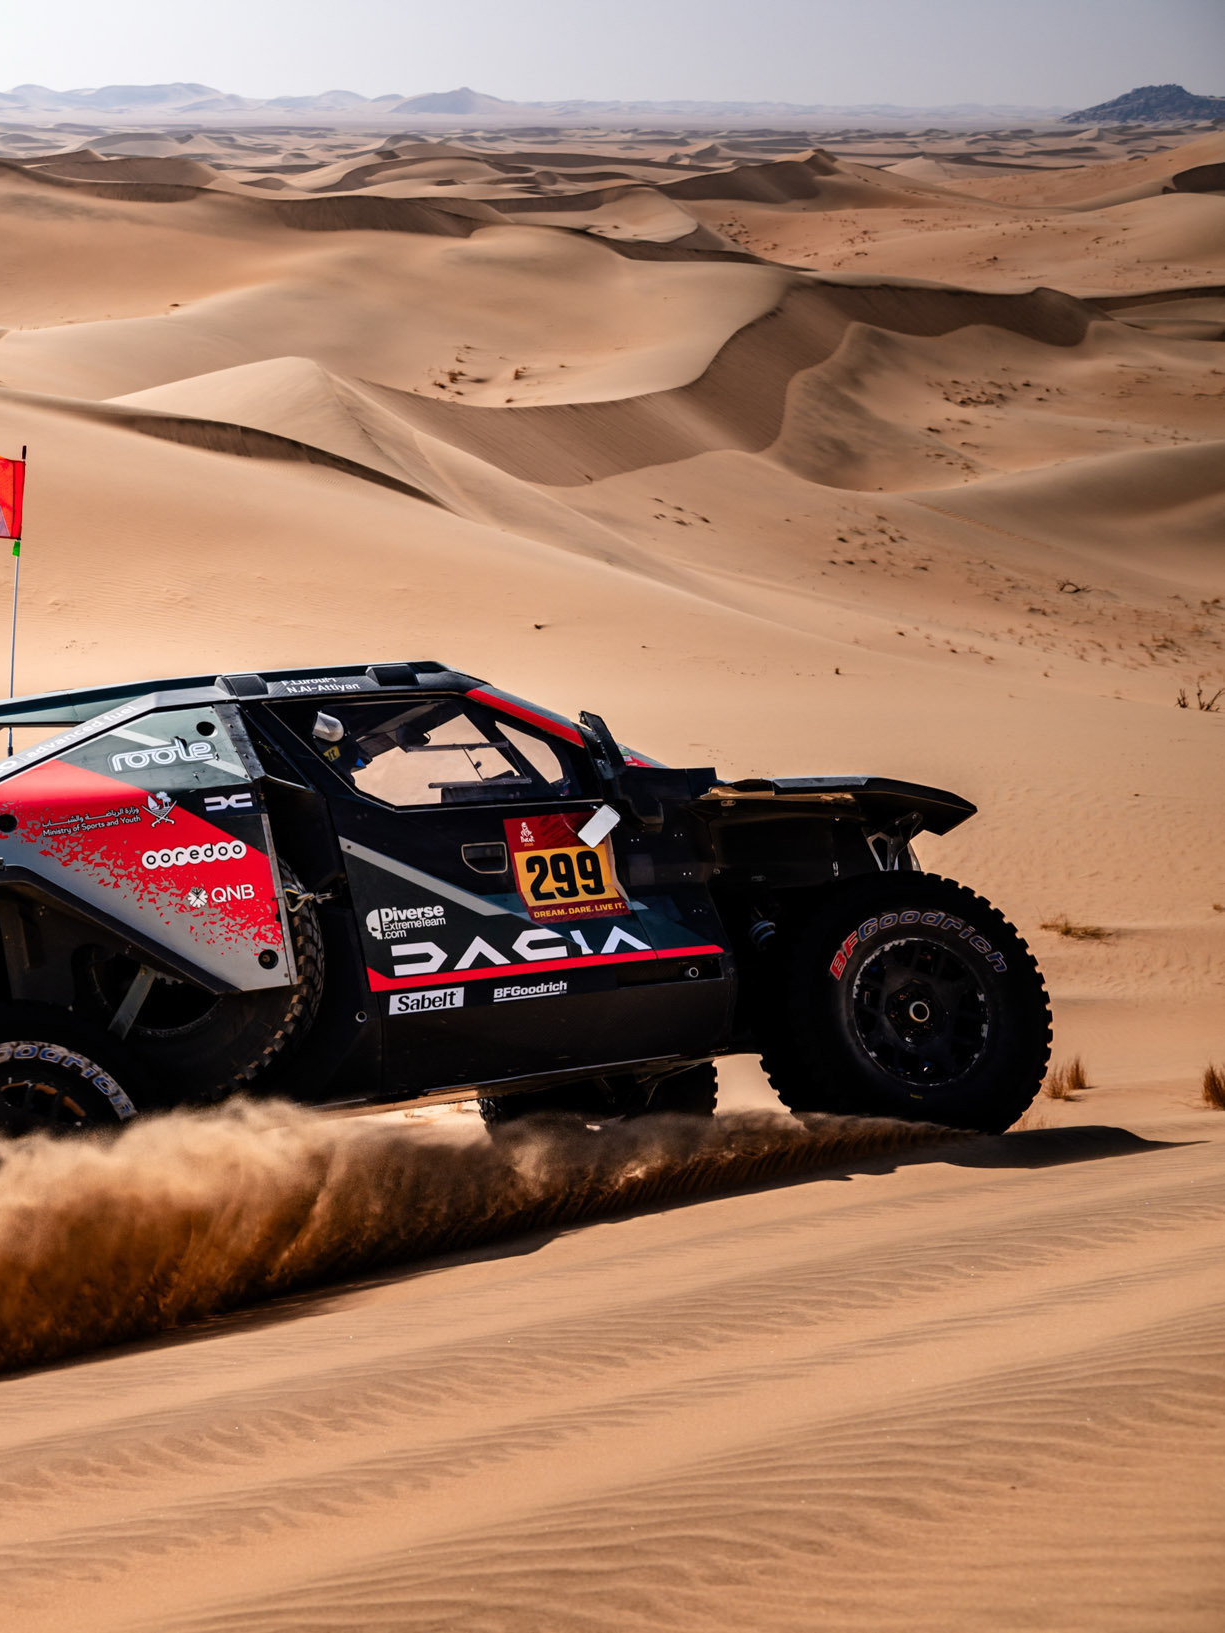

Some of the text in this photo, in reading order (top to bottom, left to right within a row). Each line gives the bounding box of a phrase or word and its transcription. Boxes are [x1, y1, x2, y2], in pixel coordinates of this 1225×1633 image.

[26, 720, 104, 759] advanced
[104, 704, 139, 723] fuel
[111, 737, 214, 772] roole
[42, 815, 141, 837] Ministry of Sports and Youth
[145, 843, 244, 866] ooredoo
[525, 850, 606, 901] 299
[211, 884, 255, 903] QNB
[380, 905, 445, 923] Diverse
[533, 902, 626, 919] DREAM. DARE. LIVE IT.
[382, 917, 446, 932] ExtremeTeam
[383, 929, 407, 940] .com
[390, 925, 653, 977] DACIA
[828, 910, 1008, 981] BFGoodrich
[493, 980, 568, 999] BFGoodrich
[397, 990, 458, 1012] Sabelt
